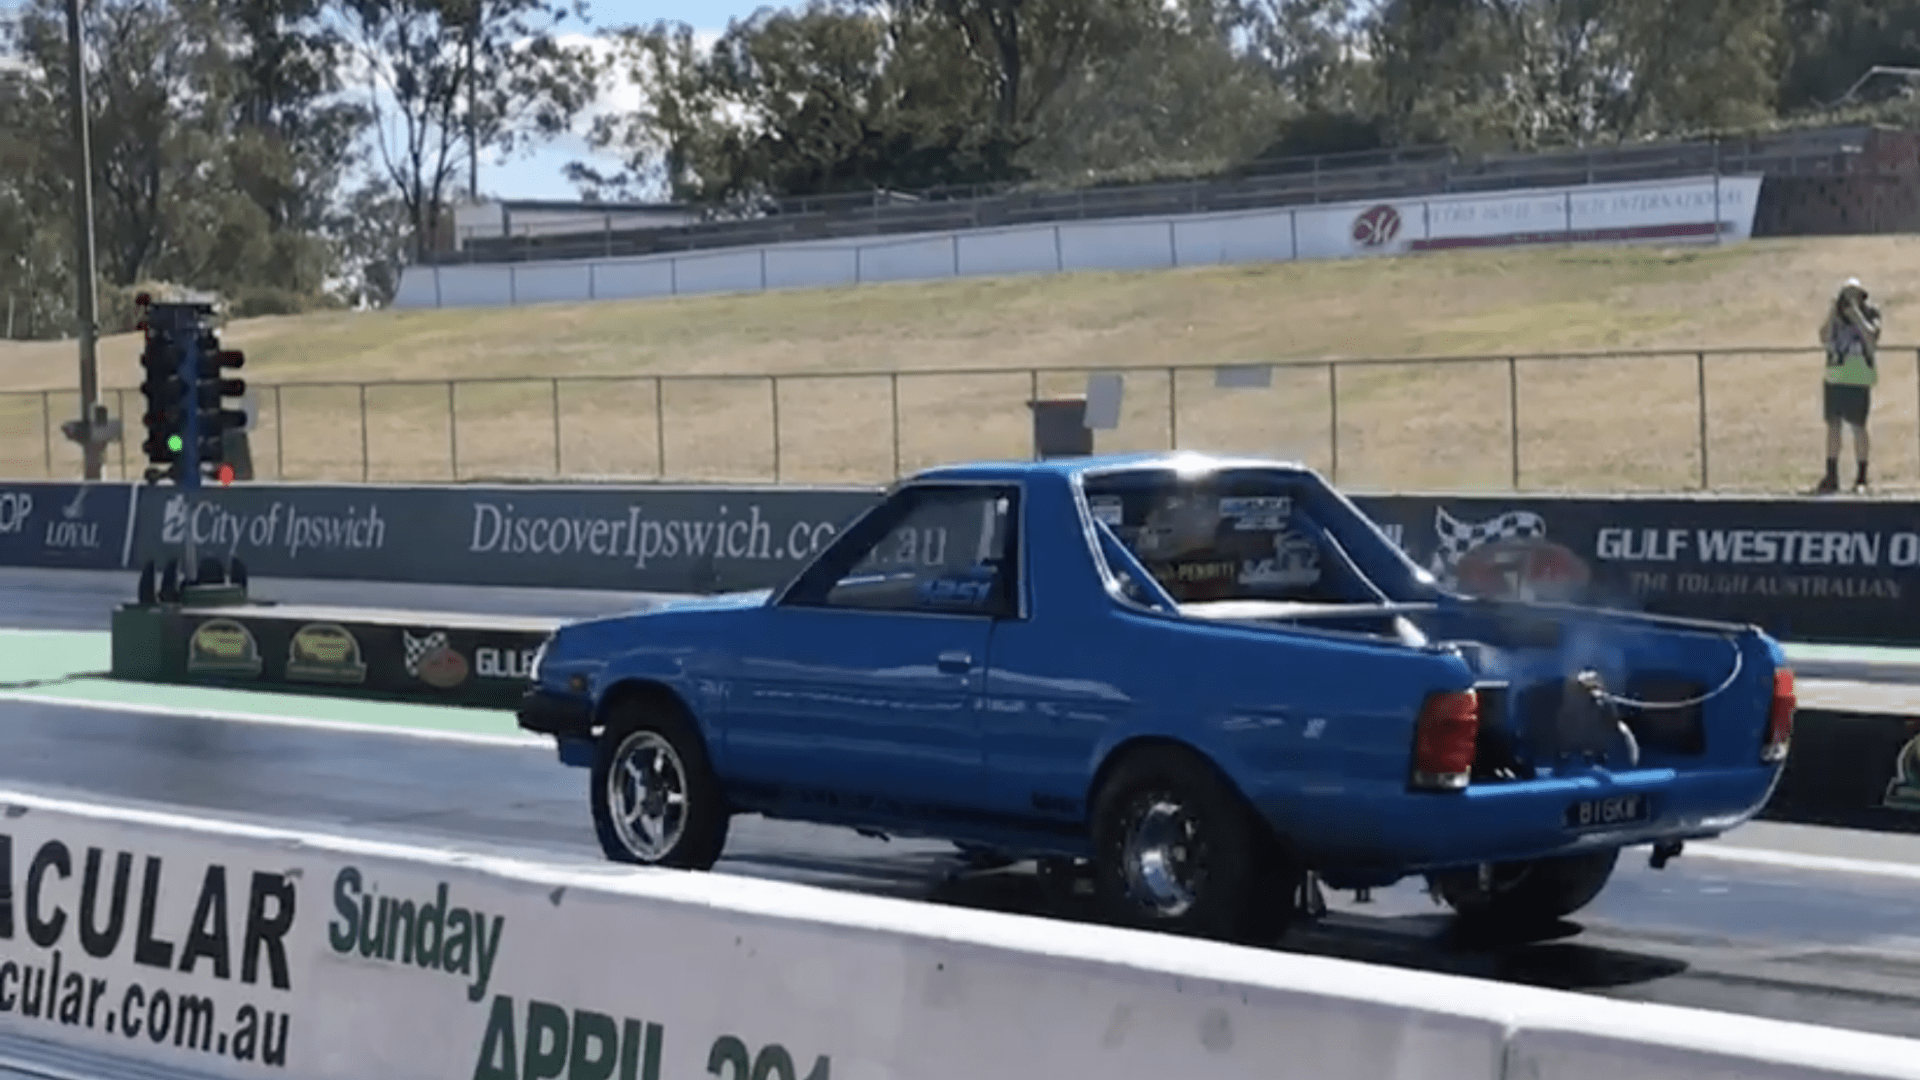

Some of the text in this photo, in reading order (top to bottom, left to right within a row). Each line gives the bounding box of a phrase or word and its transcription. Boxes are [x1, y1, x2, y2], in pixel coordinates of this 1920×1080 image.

[191, 500, 385, 559] City of Ipswich
[469, 502, 947, 568] DiscoverIpswich.co.au
[1596, 528, 1920, 567] GULF WESTERN O
[328, 866, 505, 1002] Sunday
[0, 950, 290, 1068] cular.com.au
